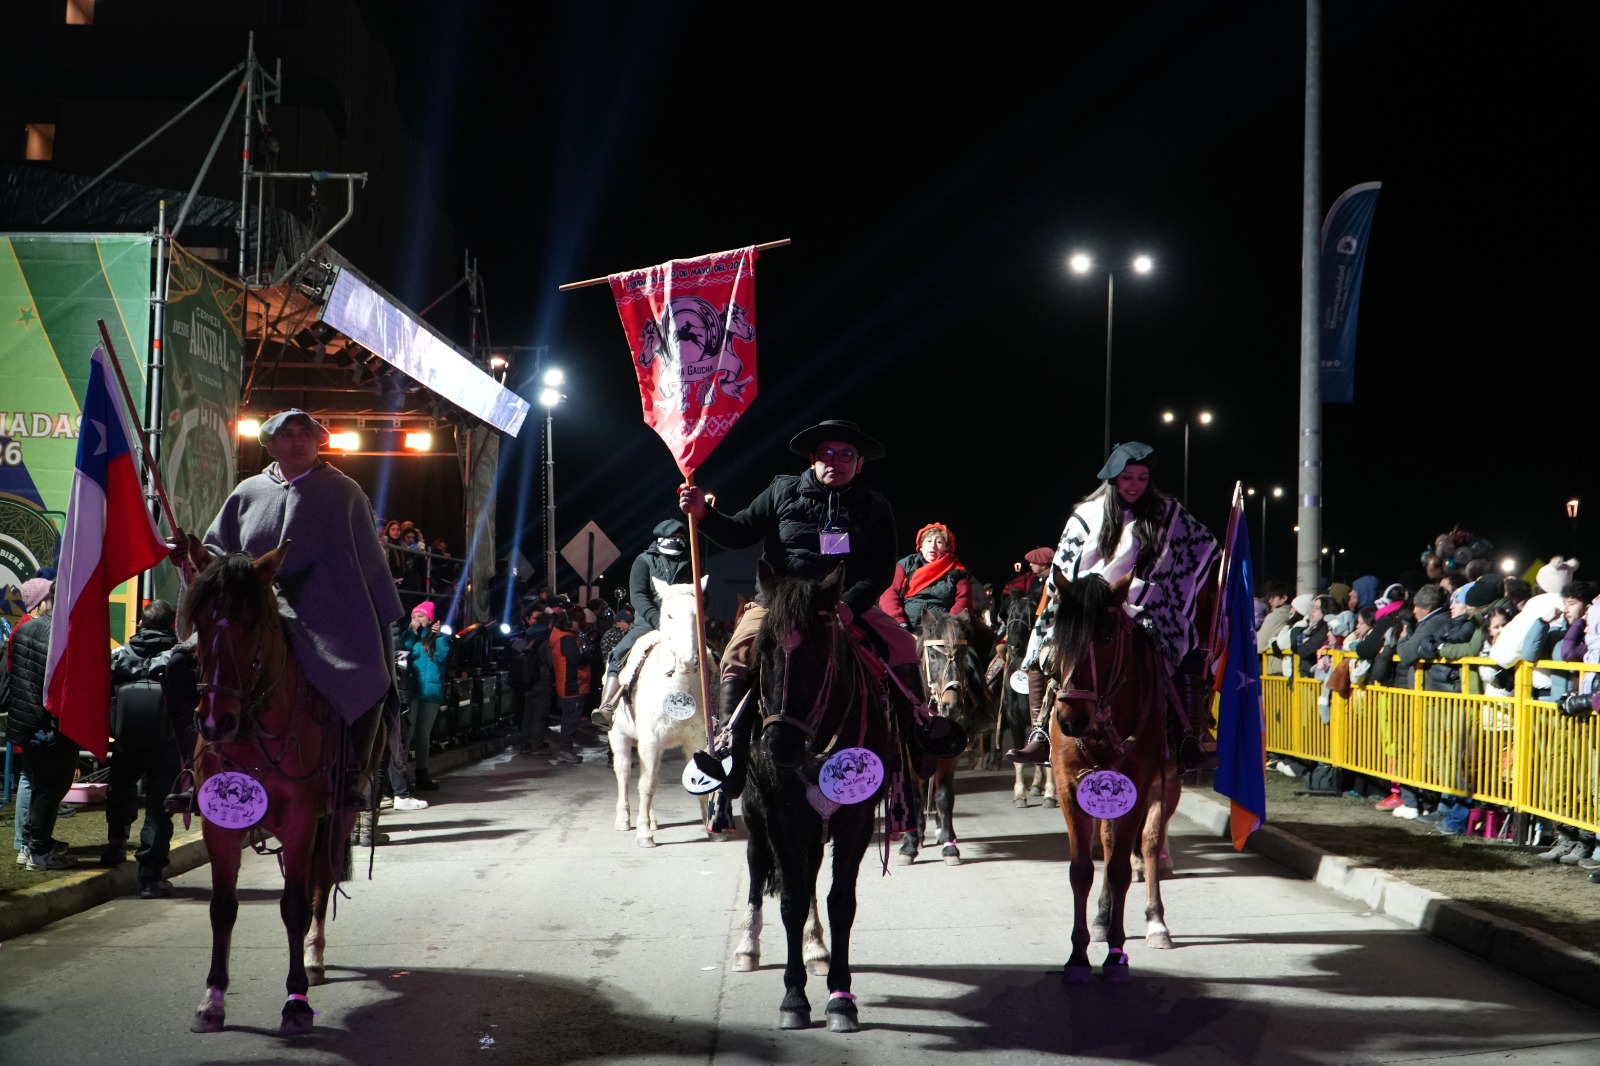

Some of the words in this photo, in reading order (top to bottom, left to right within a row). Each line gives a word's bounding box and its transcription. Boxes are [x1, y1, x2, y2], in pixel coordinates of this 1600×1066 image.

[690, 264, 711, 277] MAYO
[713, 262, 727, 273] DEL
[195, 306, 221, 329] CERVEZA
[188, 310, 229, 372] AUSTRAL
[0, 441, 22, 467] 6
